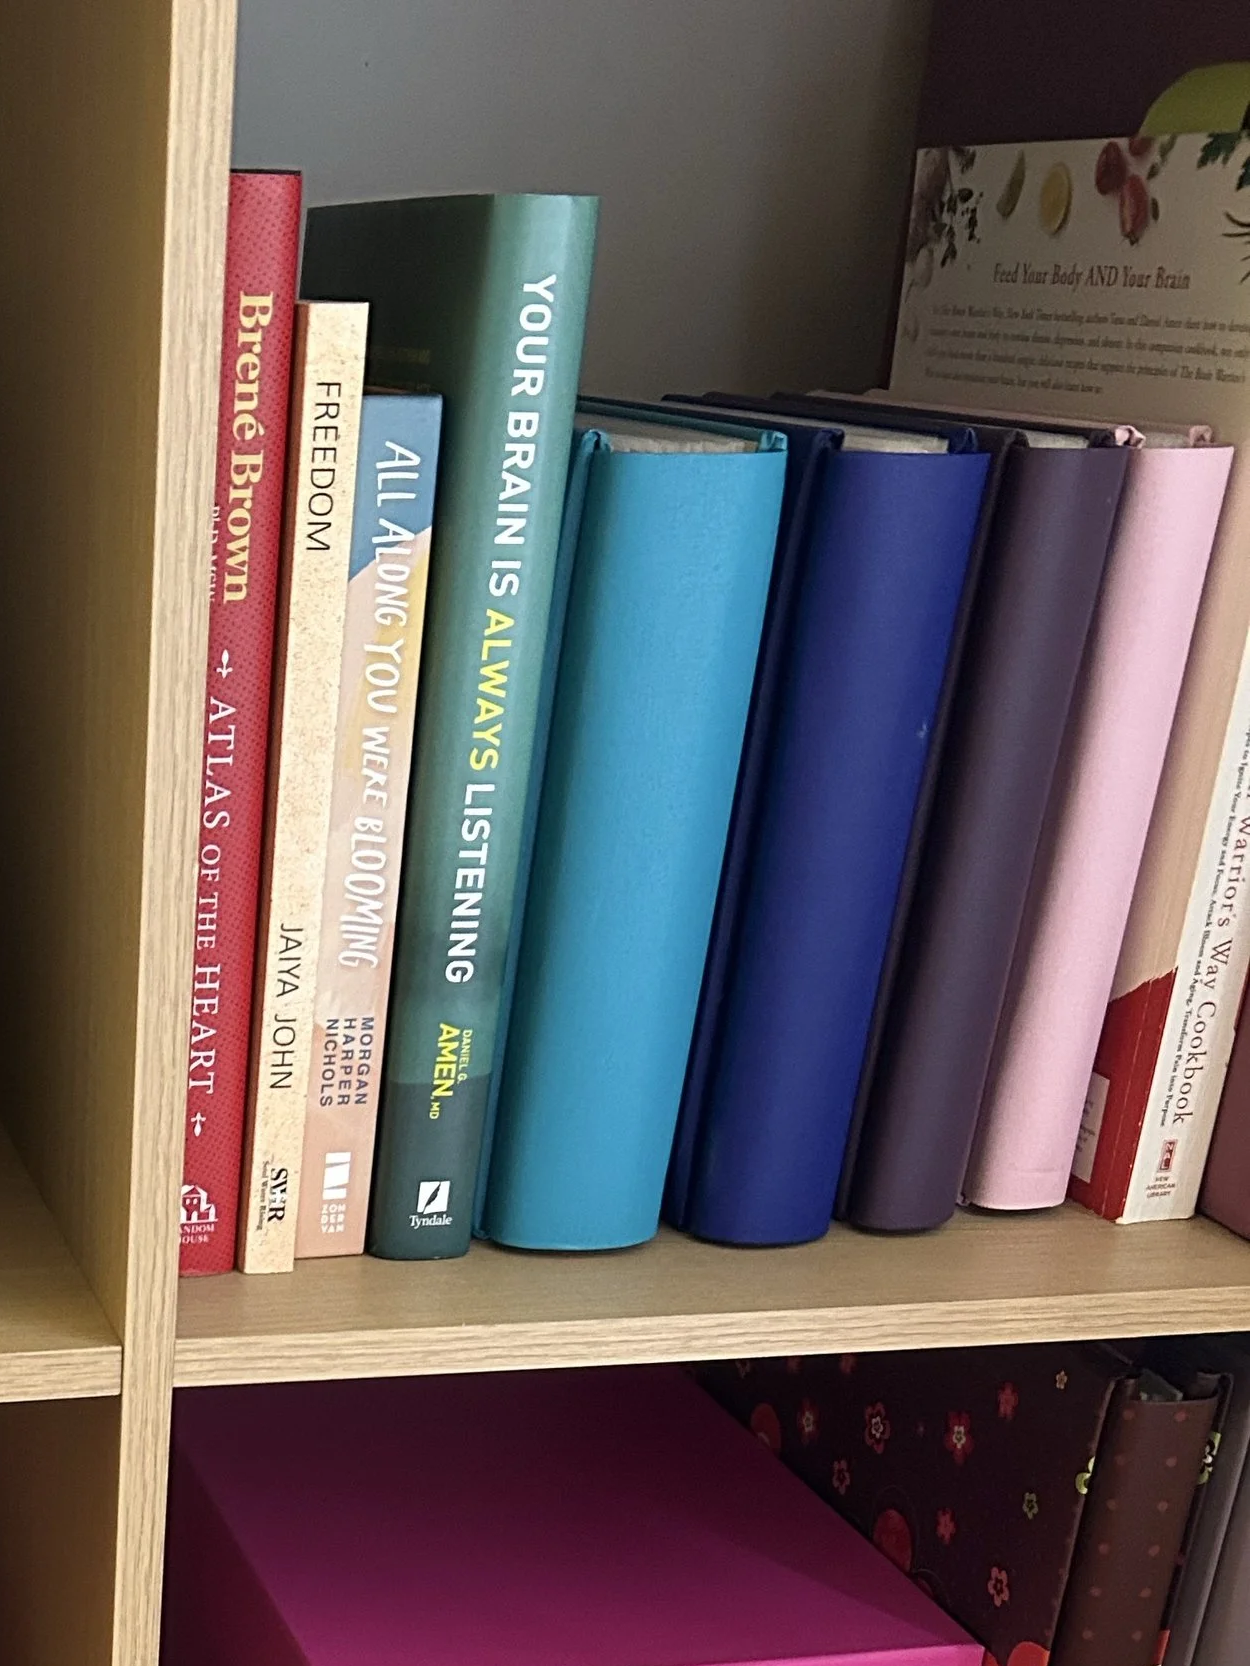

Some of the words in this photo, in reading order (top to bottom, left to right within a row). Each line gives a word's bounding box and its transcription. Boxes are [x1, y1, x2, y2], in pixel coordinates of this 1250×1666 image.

[993, 262, 1019, 284] Feed
[1022, 263, 1047, 284] Your
[1050, 263, 1084, 291] Body
[1085, 265, 1119, 287] AND
[1122, 265, 1151, 288] Your
[1155, 266, 1191, 290] Brain
[231, 291, 274, 441] Brené
[510, 274, 557, 396] YOUR
[305, 381, 342, 551] FREEDOM
[375, 440, 421, 508] ALL
[493, 411, 540, 545] BRAIN
[223, 450, 264, 604] Brown
[371, 517, 416, 627] ALONG
[488, 559, 522, 597] IS
[363, 637, 404, 714] YOU
[468, 608, 515, 771] ALWAYS
[202, 696, 237, 829] ATLAS
[360, 726, 391, 808] WERE
[199, 843, 221, 882] OF
[337, 815, 388, 970] BLOOMING
[444, 783, 496, 984] LISTENING
[1217, 816, 1250, 927] Warrior's
[196, 892, 219, 950] THE
[276, 923, 304, 998] JAIYA
[1200, 937, 1233, 990] Way
[188, 963, 221, 1094] HEART
[269, 1014, 297, 1089] JOHN
[319, 1018, 339, 1107] NICHOLS
[337, 1018, 357, 1106] HARPER
[354, 1017, 374, 1104] MORGAN
[429, 1023, 461, 1099] AMEN,
[458, 1029, 473, 1071] DANIEL
[1172, 1000, 1217, 1125] Cookbook
[429, 1102, 441, 1120] MD
[456, 1073, 468, 1085] G.
[180, 1234, 209, 1244] OUSE
[409, 1214, 453, 1230] Tyndale
